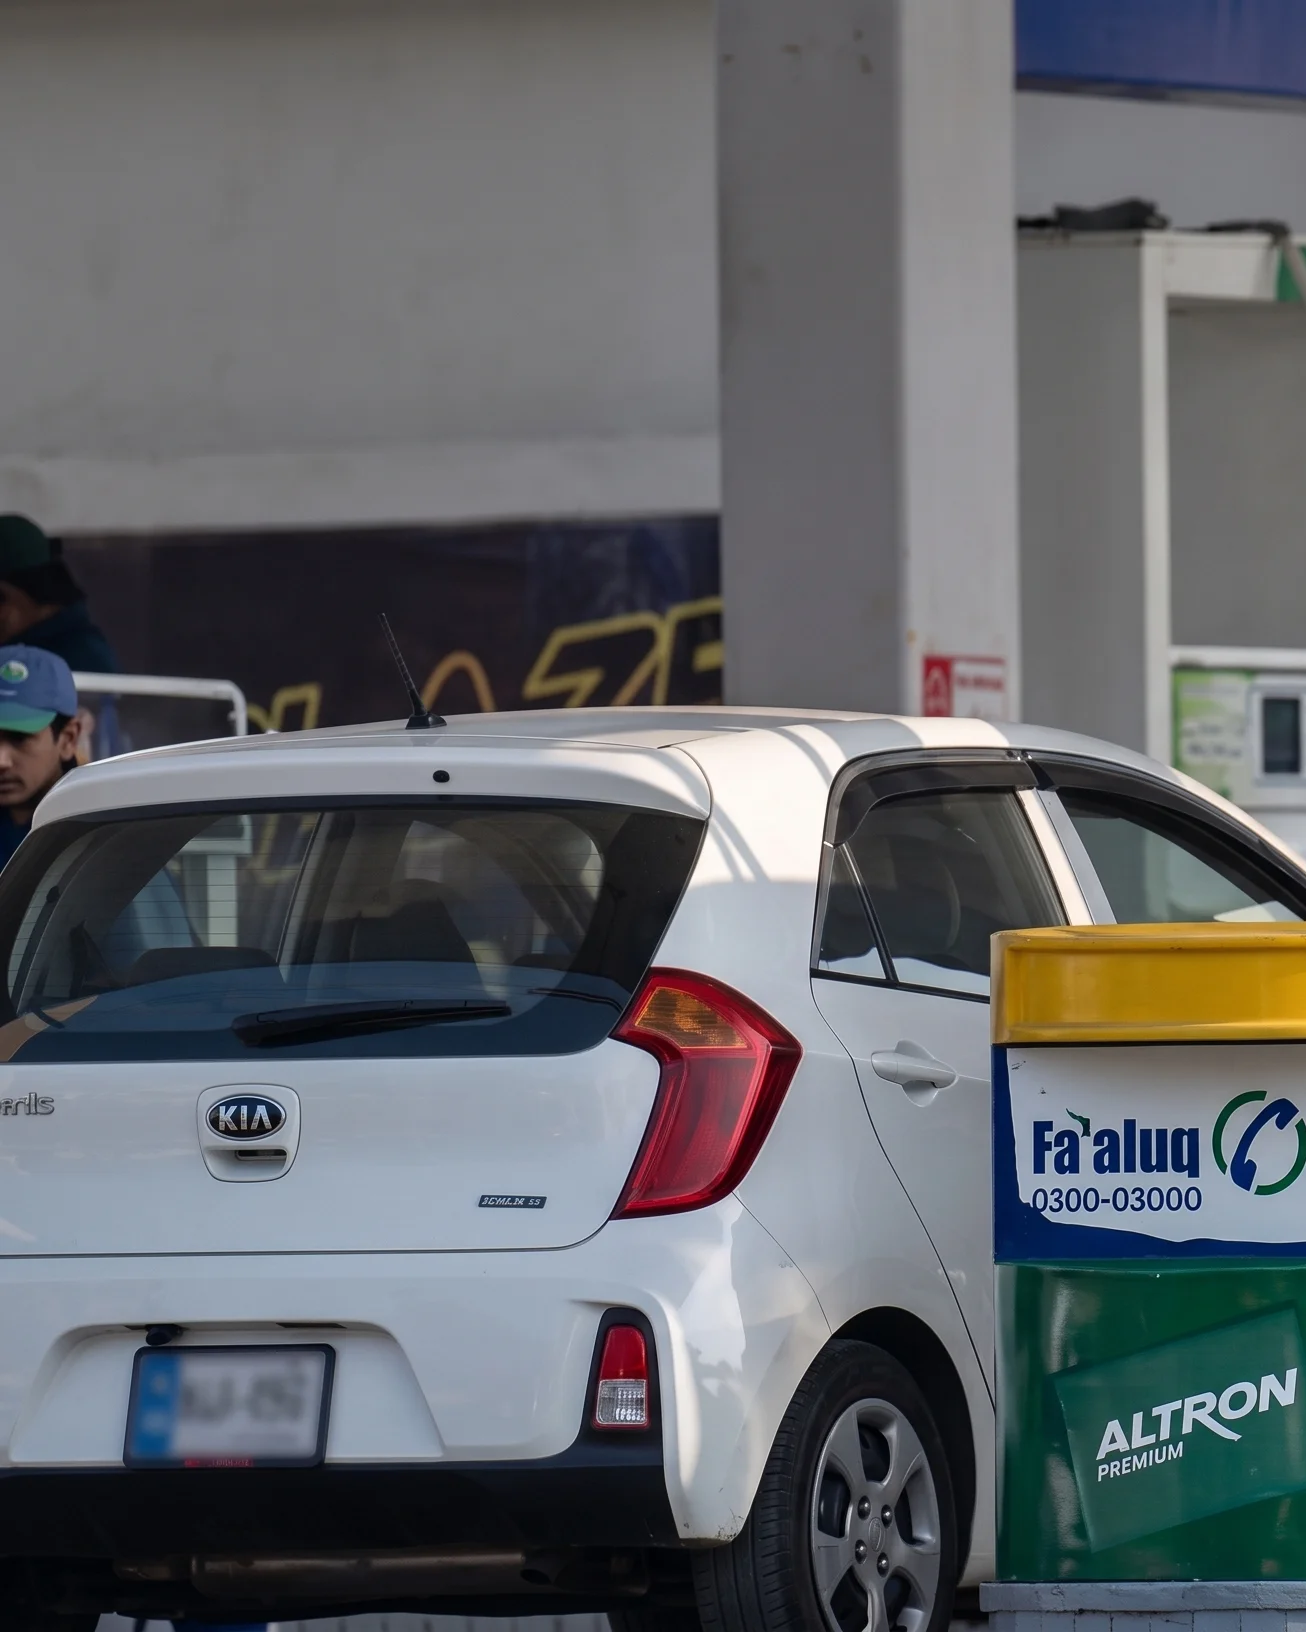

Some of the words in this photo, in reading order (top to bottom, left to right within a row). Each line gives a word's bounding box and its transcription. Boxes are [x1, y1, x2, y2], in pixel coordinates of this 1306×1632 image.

[219, 1104, 273, 1131] KIA
[1031, 1186, 1203, 1213] 0300-03000
[1096, 1367, 1298, 1461] ALTRON
[1097, 1441, 1184, 1482] PREMIUM
